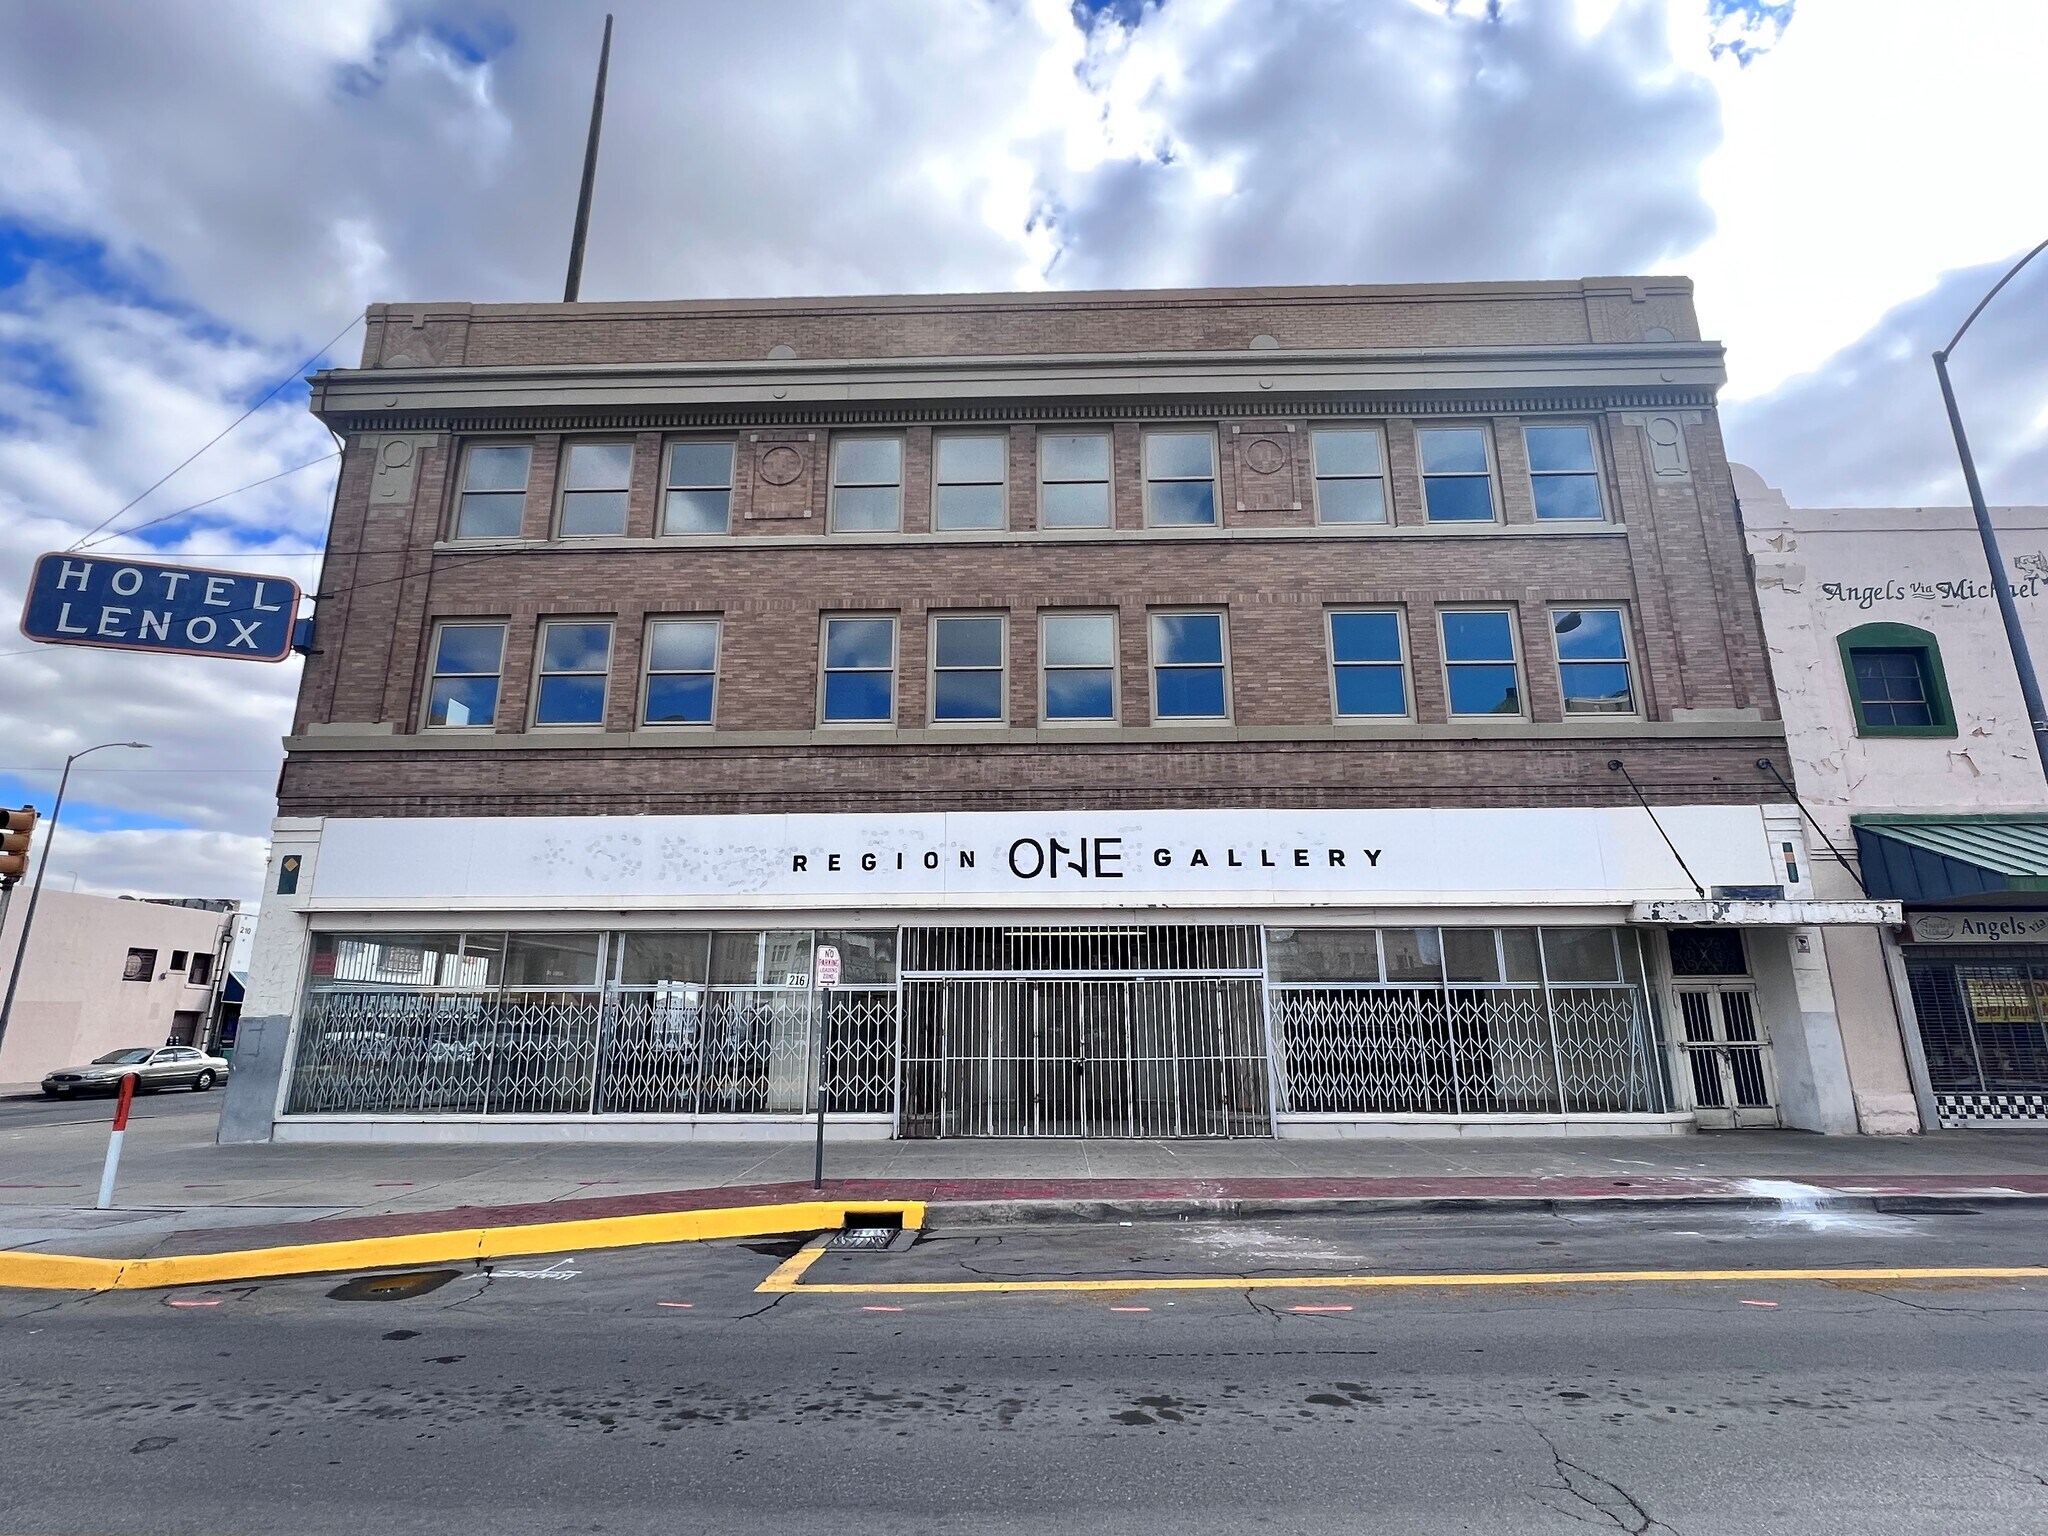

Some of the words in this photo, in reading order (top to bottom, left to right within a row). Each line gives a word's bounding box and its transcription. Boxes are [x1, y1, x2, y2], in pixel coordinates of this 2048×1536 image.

[56, 560, 281, 612] HOTEL
[1822, 580, 1905, 609] Angels
[1909, 581, 1934, 594] Via
[56, 602, 262, 649] LENOX
[793, 851, 975, 871] REGION
[1009, 838, 1124, 878] ONE
[1154, 848, 1382, 867] GALLERY
[1961, 916, 2026, 941] Angels
[819, 959, 839, 967] PARKING
[825, 949, 834, 958] NO
[789, 975, 805, 986] 216
